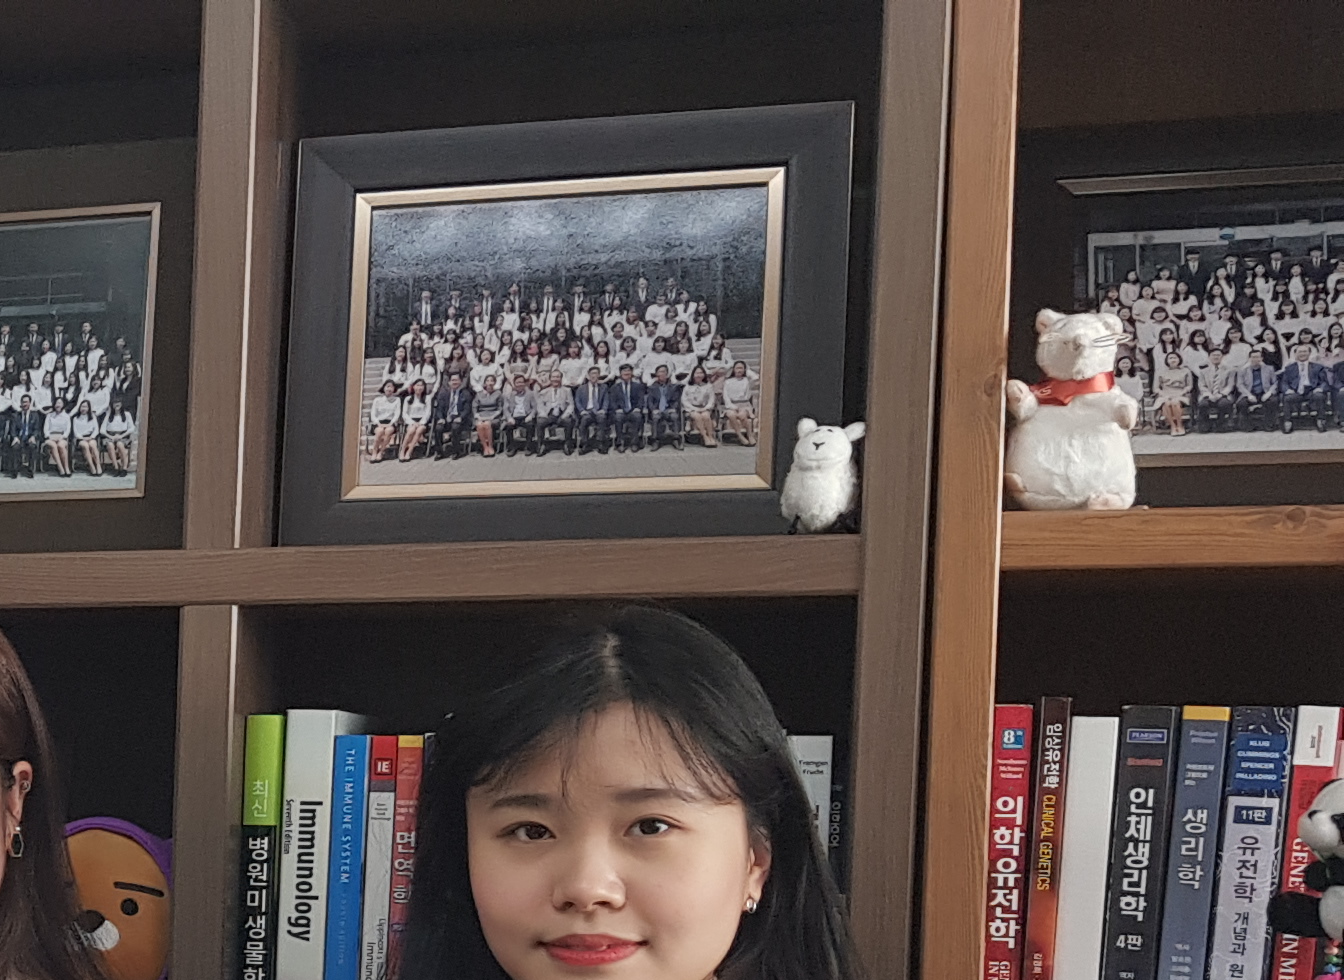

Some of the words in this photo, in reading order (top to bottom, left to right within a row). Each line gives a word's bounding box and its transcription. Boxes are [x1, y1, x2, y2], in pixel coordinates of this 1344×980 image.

[344, 748, 356, 772] THE
[377, 762, 390, 773] IE
[1042, 723, 1062, 788] 임상유전학
[252, 780, 268, 817] 최신
[342, 778, 355, 830] IMMUNE
[1042, 794, 1055, 839] CLINICAL
[1241, 810, 1267, 822] 11판
[287, 801, 323, 942] Immunology
[339, 836, 351, 883] SYSTEM
[1037, 841, 1053, 890] GENETICS
[1120, 788, 1156, 921] 인체생리학
[1178, 808, 1208, 890] 생리학
[1234, 836, 1257, 903] 유전학
[988, 796, 1025, 949] 의학유전학
[1116, 934, 1143, 950] 4판
[1230, 912, 1250, 957] 개념과
[1282, 932, 1300, 950] IN
[988, 961, 1000, 974] IN
